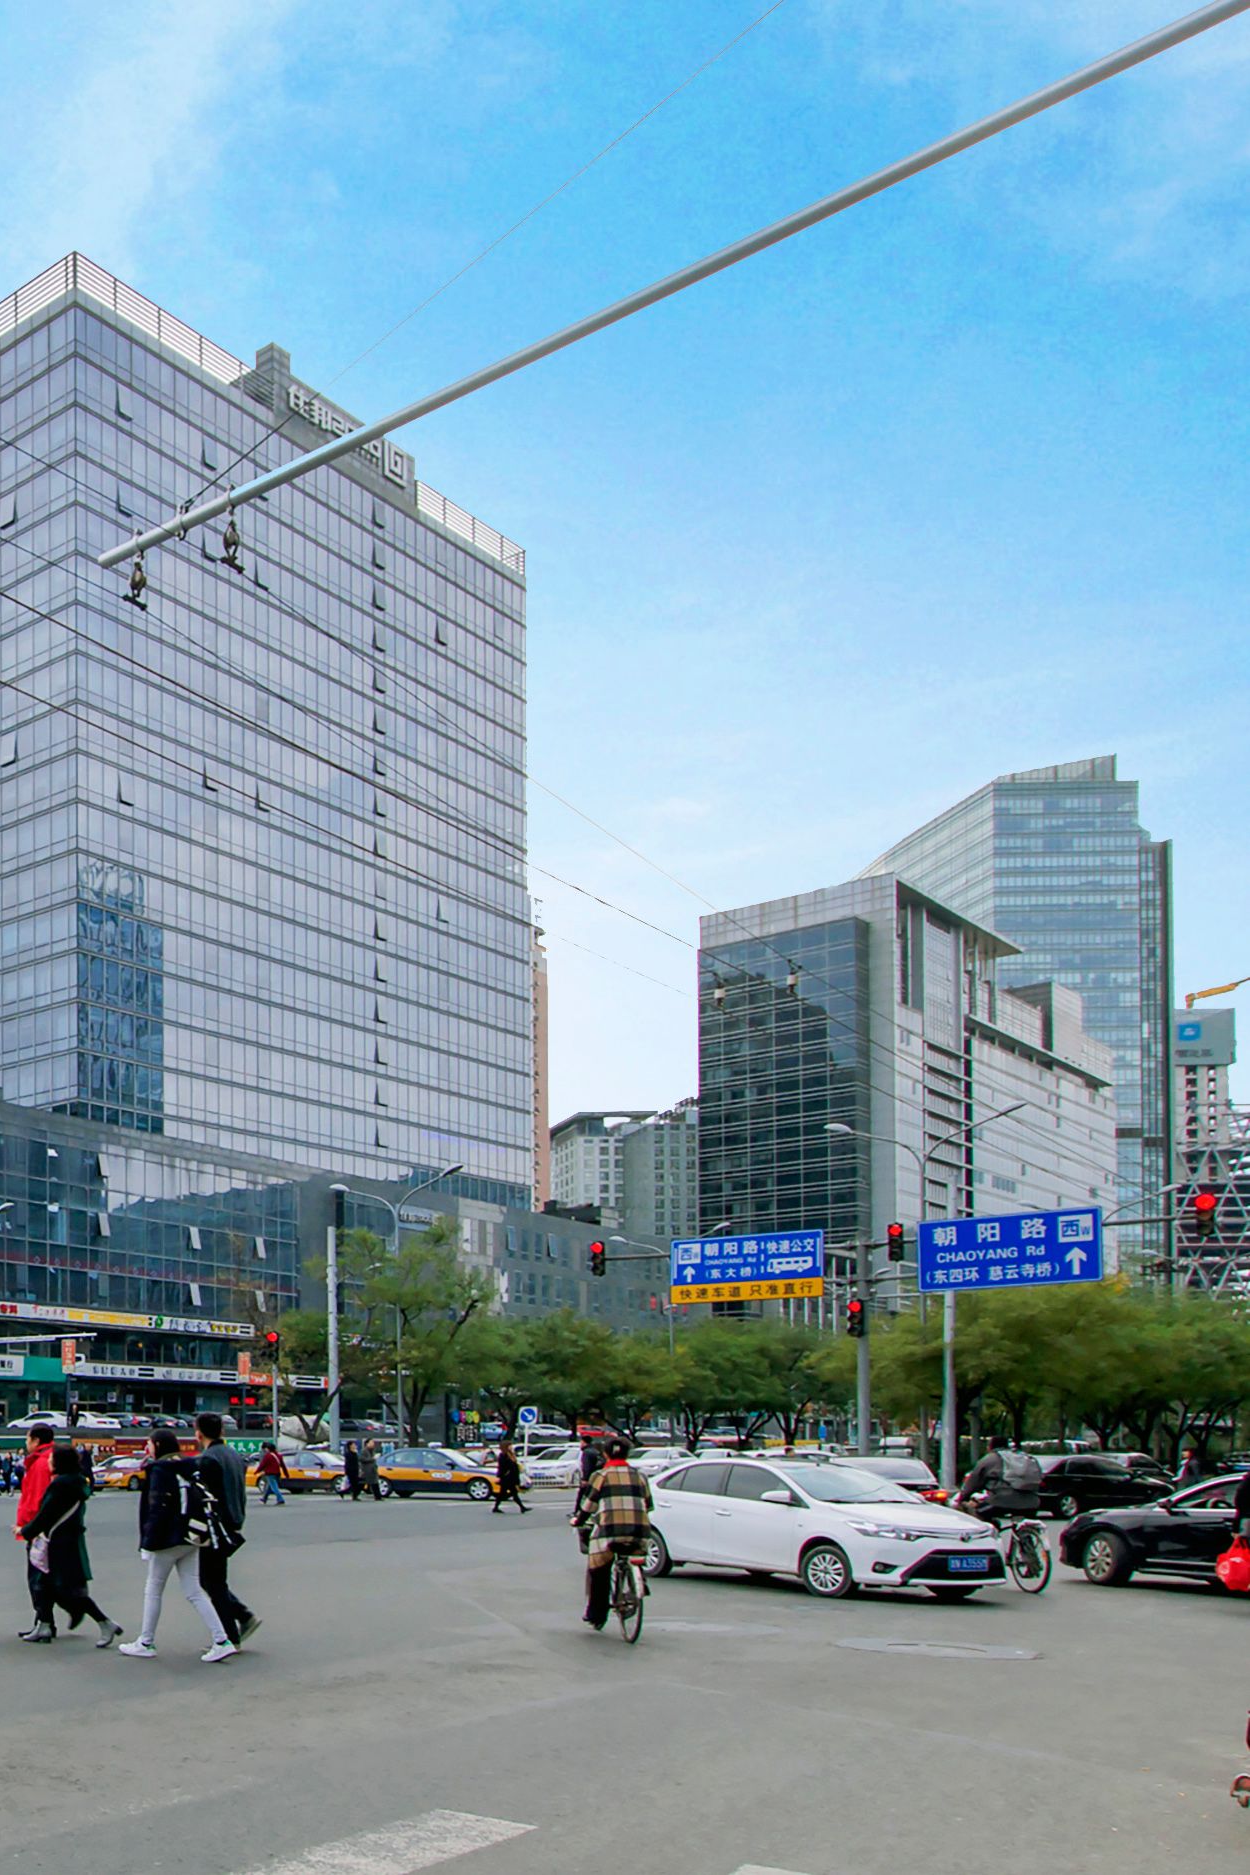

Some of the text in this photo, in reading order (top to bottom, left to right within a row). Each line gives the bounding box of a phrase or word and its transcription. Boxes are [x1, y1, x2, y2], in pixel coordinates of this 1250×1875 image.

[932, 1218, 1047, 1247] 朝阳路
[1060, 1219, 1080, 1238] 西
[1081, 1226, 1090, 1236] W
[704, 1240, 759, 1257] 朝阳路
[767, 1238, 815, 1254] 快速公交
[936, 1245, 1046, 1264] CHAOYANG Rd
[680, 1281, 813, 1300] 快速车道 只准直行
